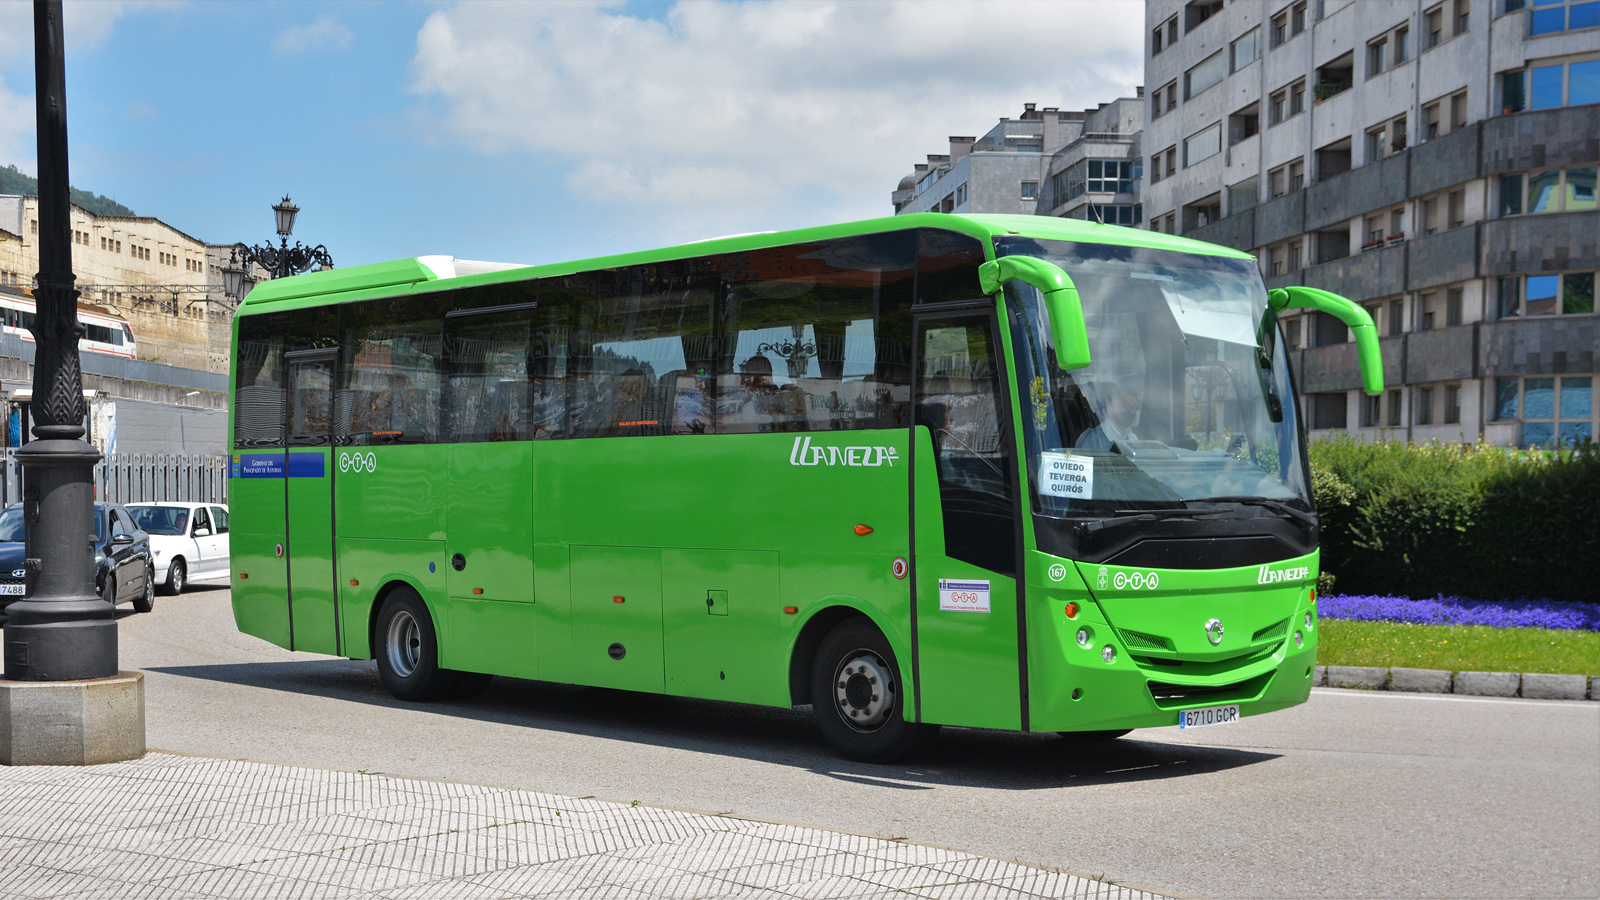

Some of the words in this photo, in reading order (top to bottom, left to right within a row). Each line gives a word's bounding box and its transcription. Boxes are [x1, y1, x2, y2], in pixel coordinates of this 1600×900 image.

[790, 436, 899, 466] LLANEZA
[1053, 462, 1084, 471] OVIEDO
[1049, 472, 1086, 483] TEVERGA
[1051, 484, 1083, 493] QUIRÓS
[1050, 566, 1064, 578] 167
[2, 586, 23, 594] 7488
[1186, 710, 1213, 726] 6710
[1216, 707, 1236, 722] GCR
